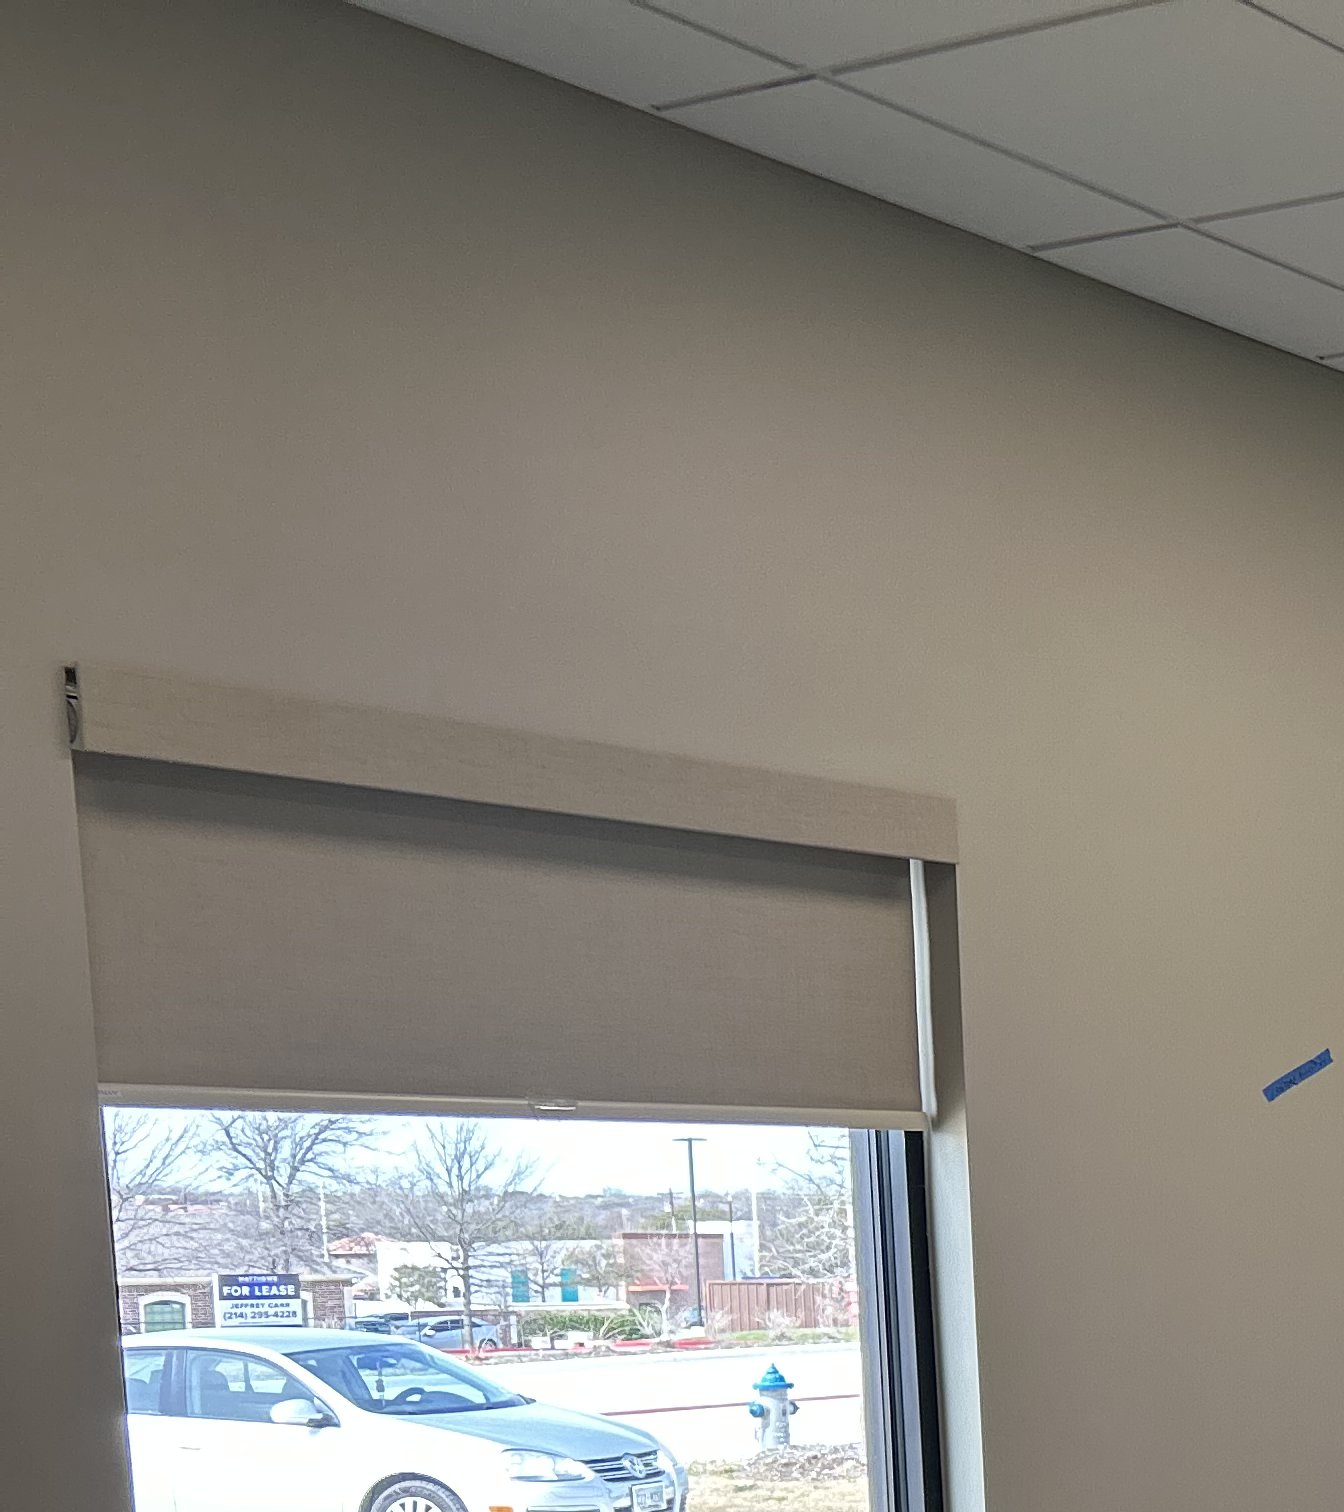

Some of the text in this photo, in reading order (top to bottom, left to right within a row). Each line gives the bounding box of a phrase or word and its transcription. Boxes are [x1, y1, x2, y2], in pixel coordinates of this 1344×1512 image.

[222, 1284, 296, 1297] FOR LEASE
[223, 1311, 248, 1321] (214)
